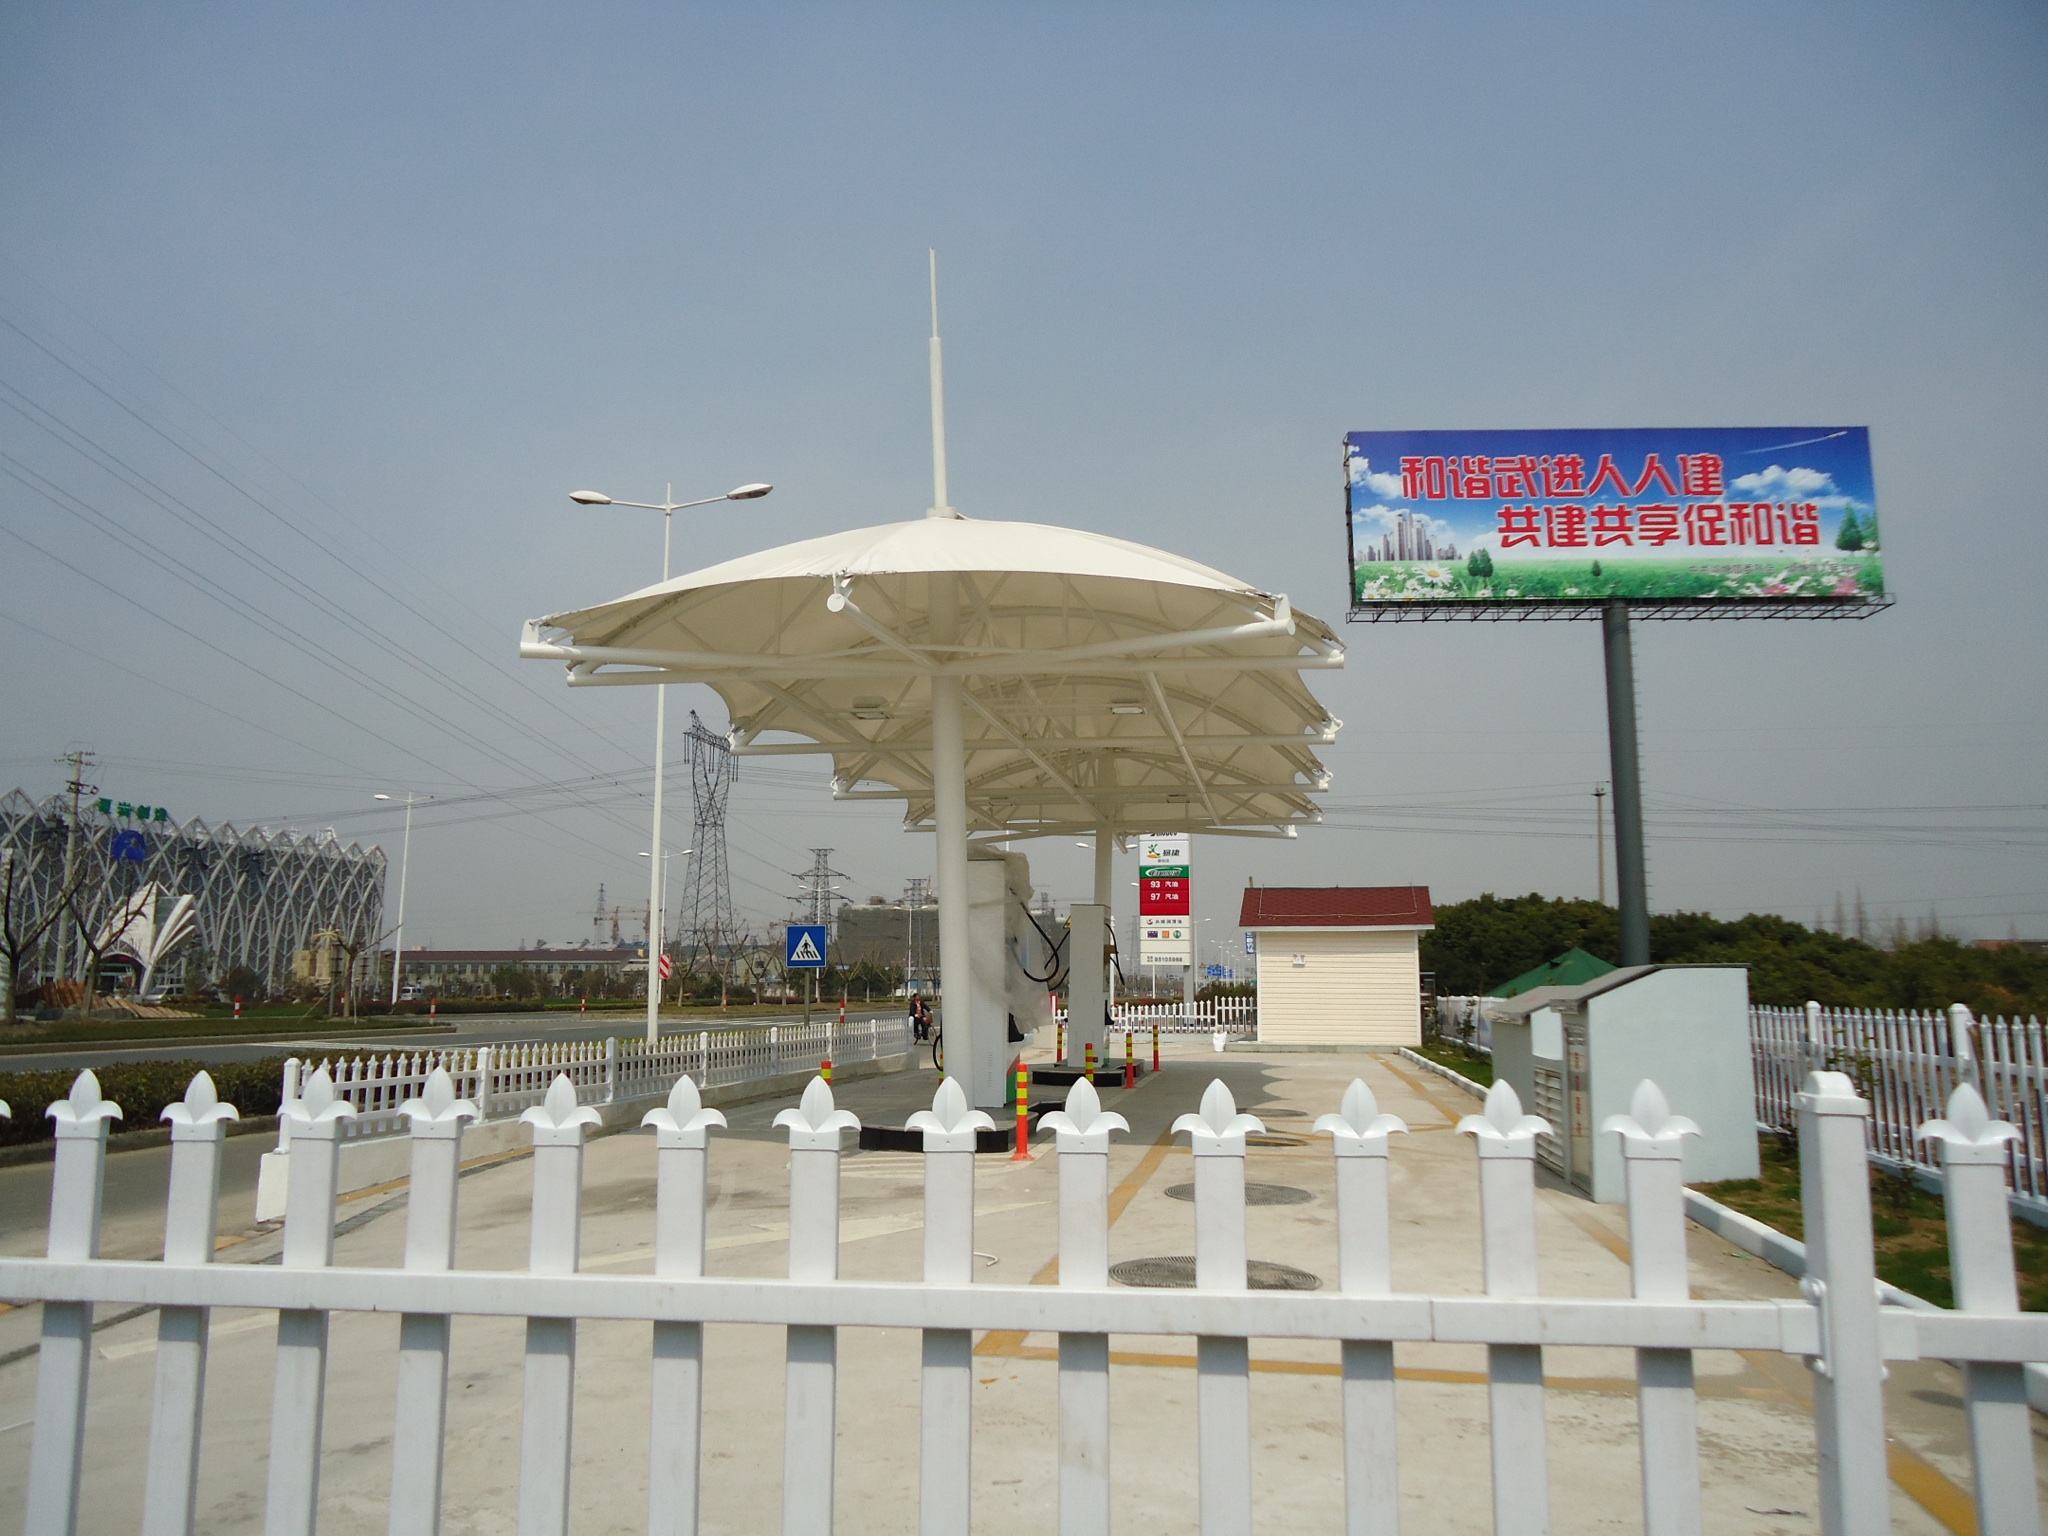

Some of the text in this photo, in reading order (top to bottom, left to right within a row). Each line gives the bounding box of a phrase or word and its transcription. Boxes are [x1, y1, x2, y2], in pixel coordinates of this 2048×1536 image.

[1401, 454, 1723, 499] 和谐武进人人建
[1497, 503, 1820, 547] 共建共享促和谐
[1151, 880, 1160, 888] 93
